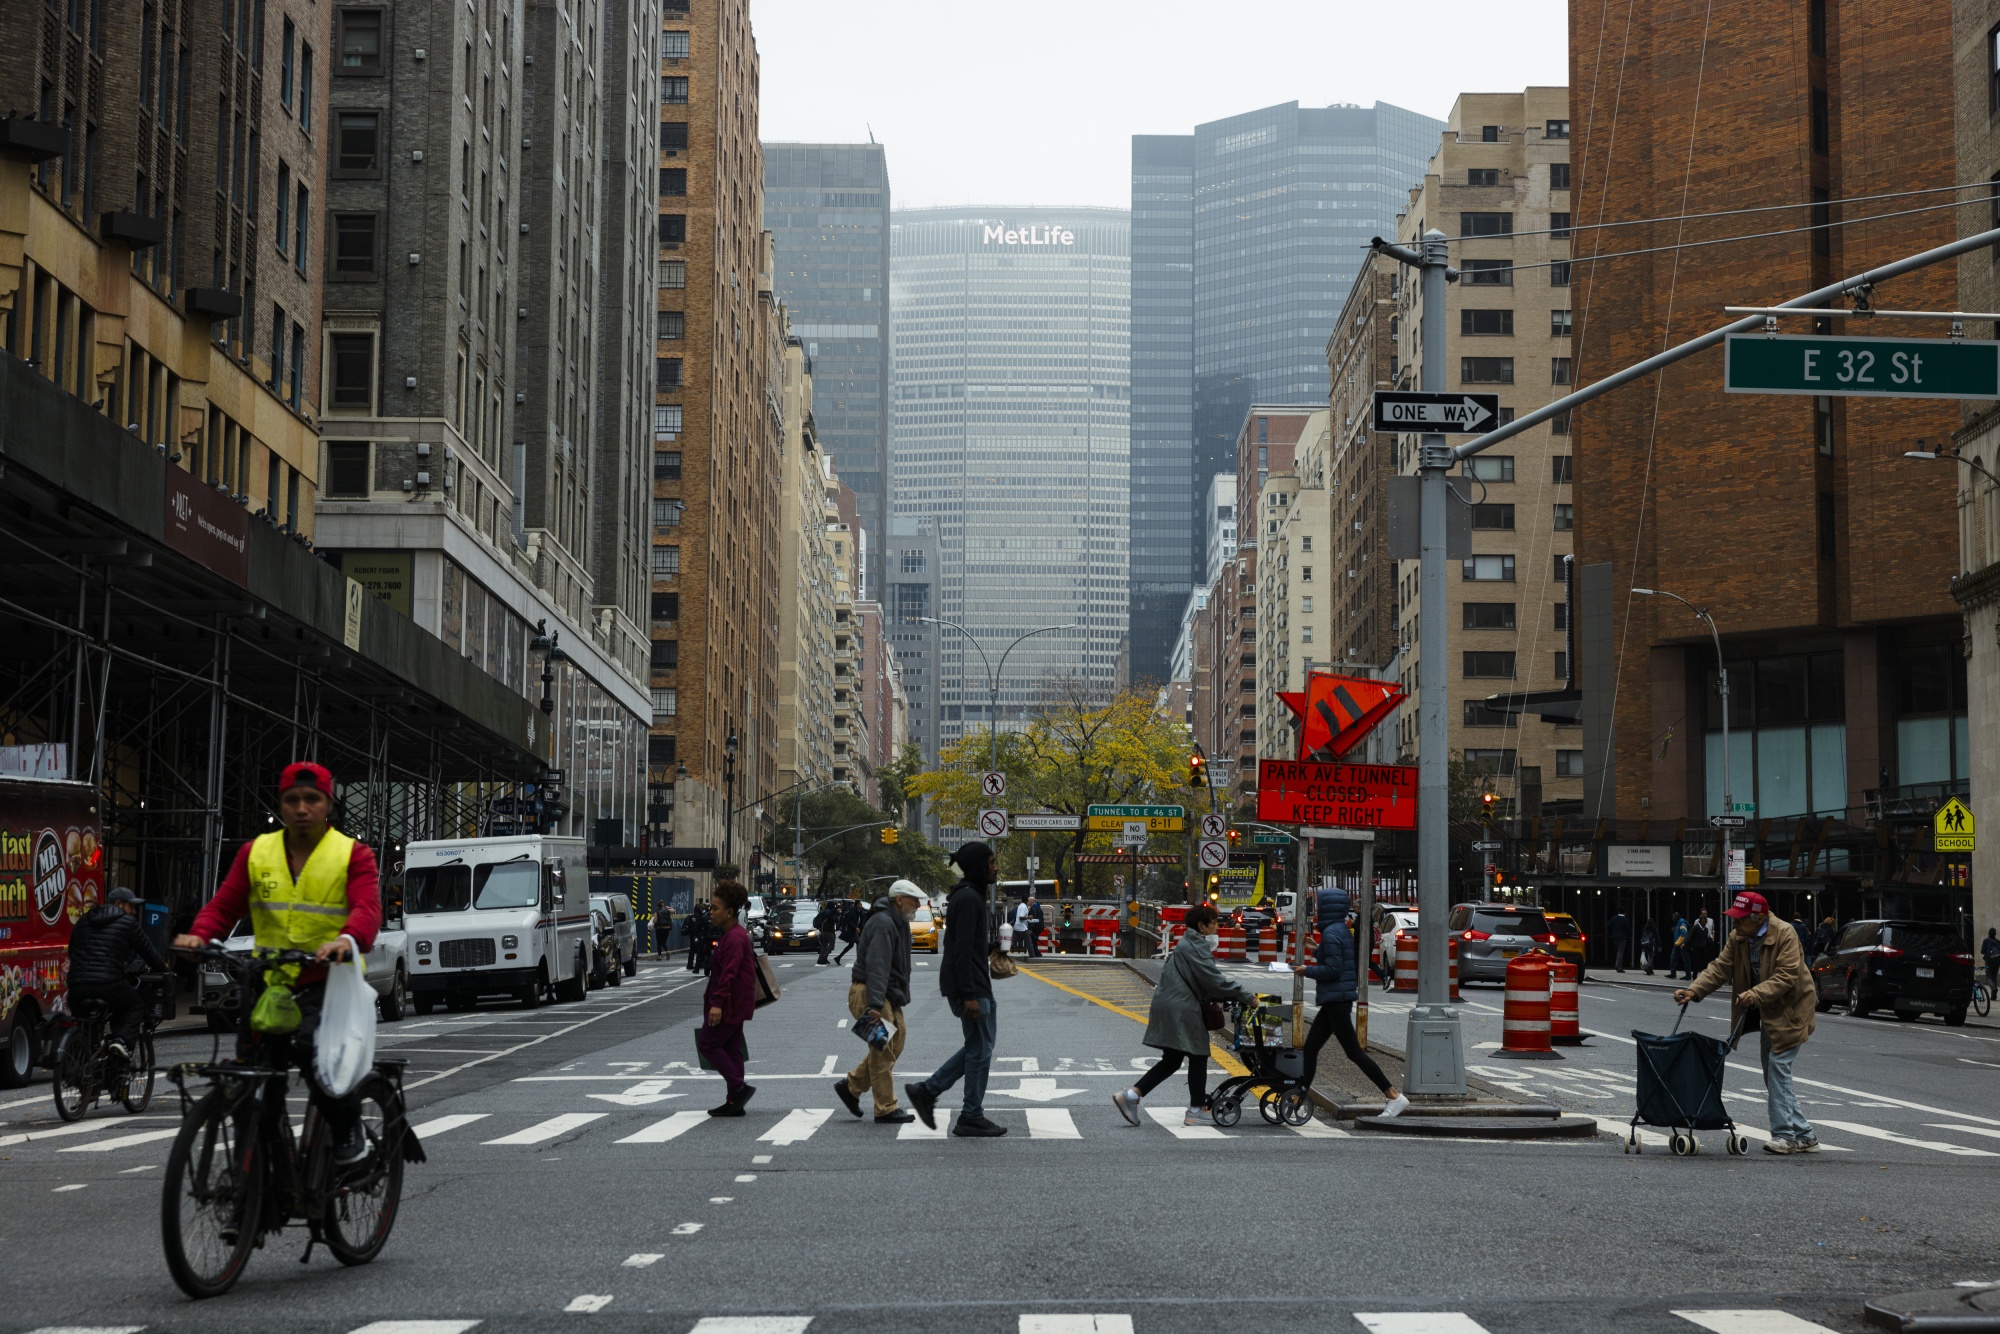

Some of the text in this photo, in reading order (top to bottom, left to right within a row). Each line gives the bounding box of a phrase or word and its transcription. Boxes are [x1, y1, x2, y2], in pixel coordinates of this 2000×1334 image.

[984, 226, 1074, 245] MetLife
[1804, 349, 1923, 384] E 32 St
[1393, 405, 1479, 421] ONE WAY
[176, 490, 189, 522] PRET
[1267, 764, 1409, 786] PARK AVE TUNNEL
[1307, 785, 1367, 803] CLOSED
[1094, 808, 1126, 816] TUNNEL
[1130, 808, 1140, 816] TO
[1143, 808, 1149, 816] E
[1168, 809, 1178, 817] ST
[1293, 804, 1384, 825] KEEP RIGHT
[1738, 803, 1746, 811] 33
[1125, 834, 1146, 842] TURNS
[1938, 839, 1973, 847] SCHOOL
[0, 831, 32, 871] fast
[39, 843, 59, 877] MR
[639, 859, 661, 867] PARK
[662, 859, 694, 867] AVENUE
[0, 878, 27, 917] nch
[34, 867, 66, 911] TIMO
[151, 913, 159, 925] P
